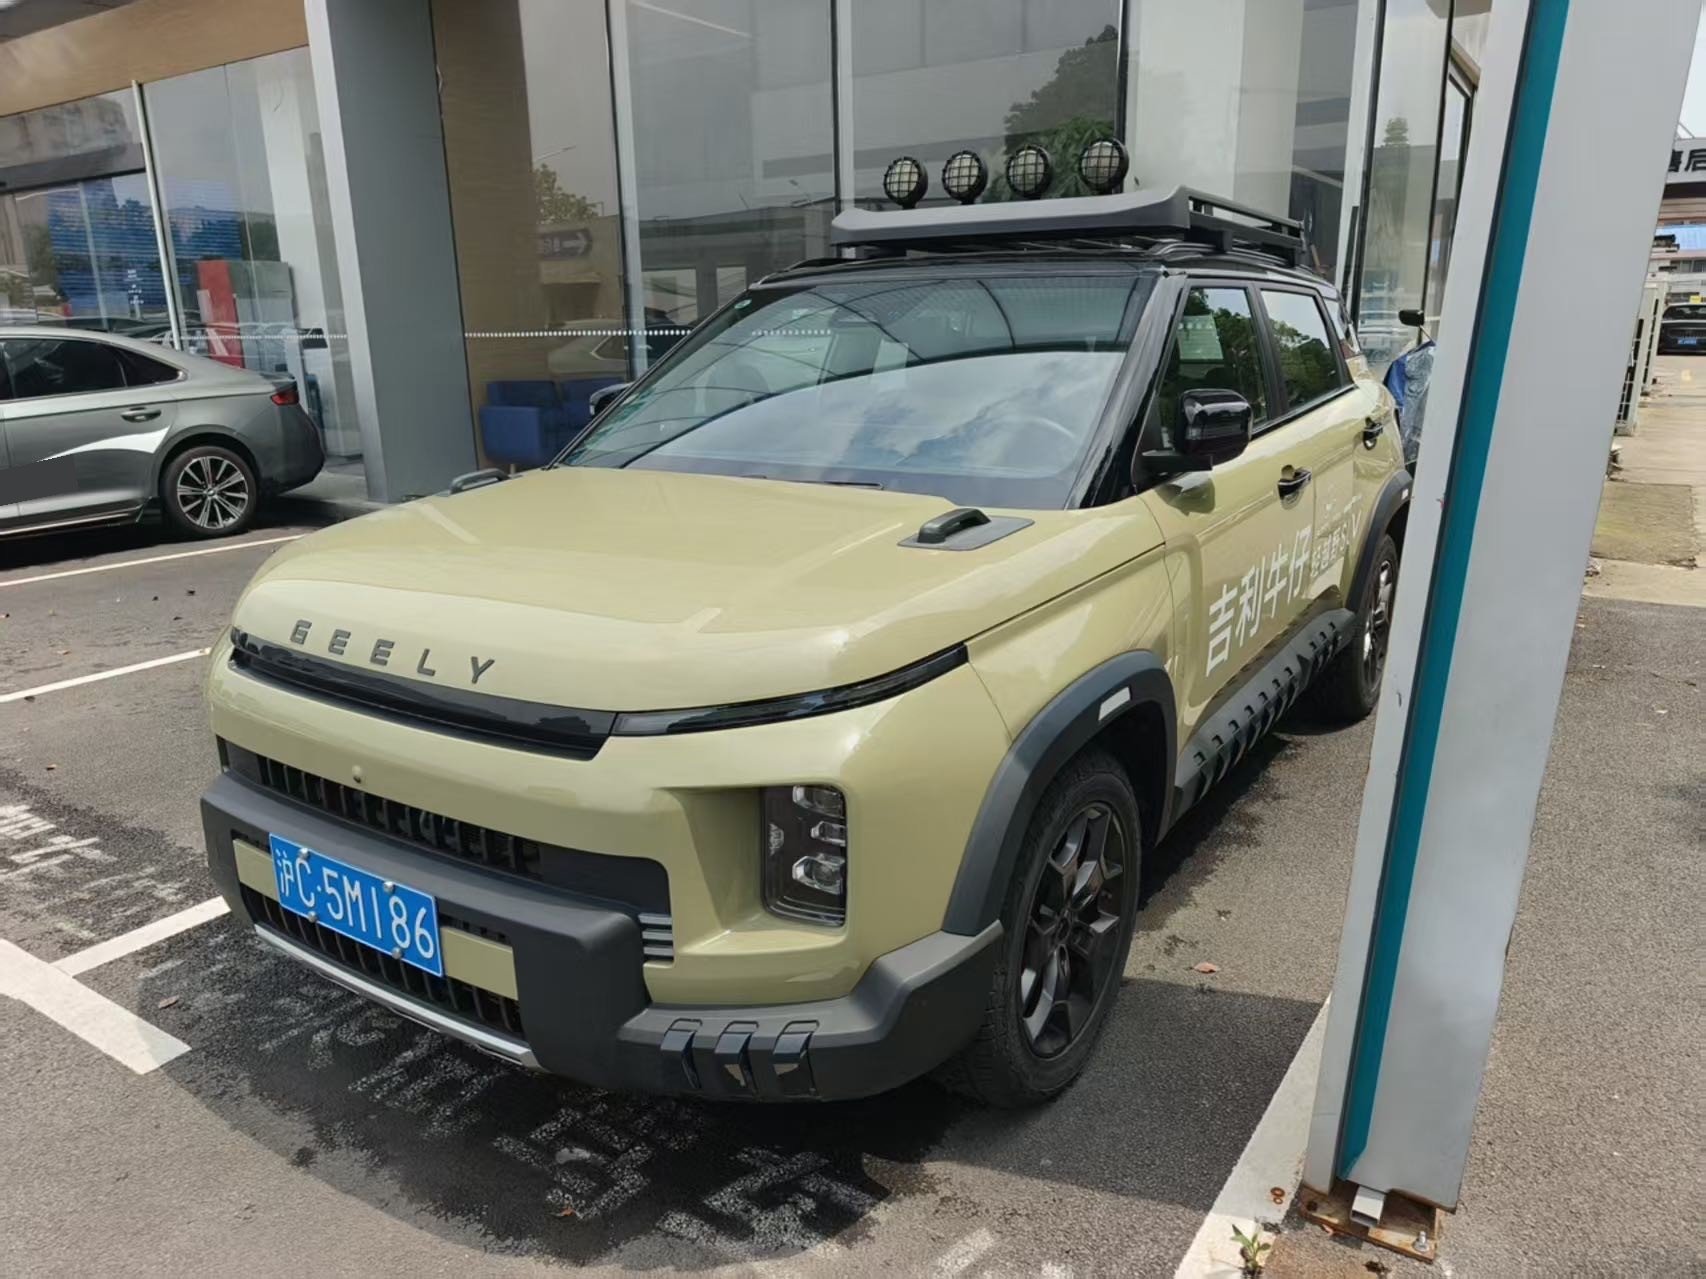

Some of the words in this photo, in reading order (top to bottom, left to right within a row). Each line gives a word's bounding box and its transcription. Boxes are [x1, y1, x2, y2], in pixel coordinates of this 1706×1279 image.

[290, 619, 496, 684] GEELY
[1206, 526, 1311, 677] 吉利牛仔
